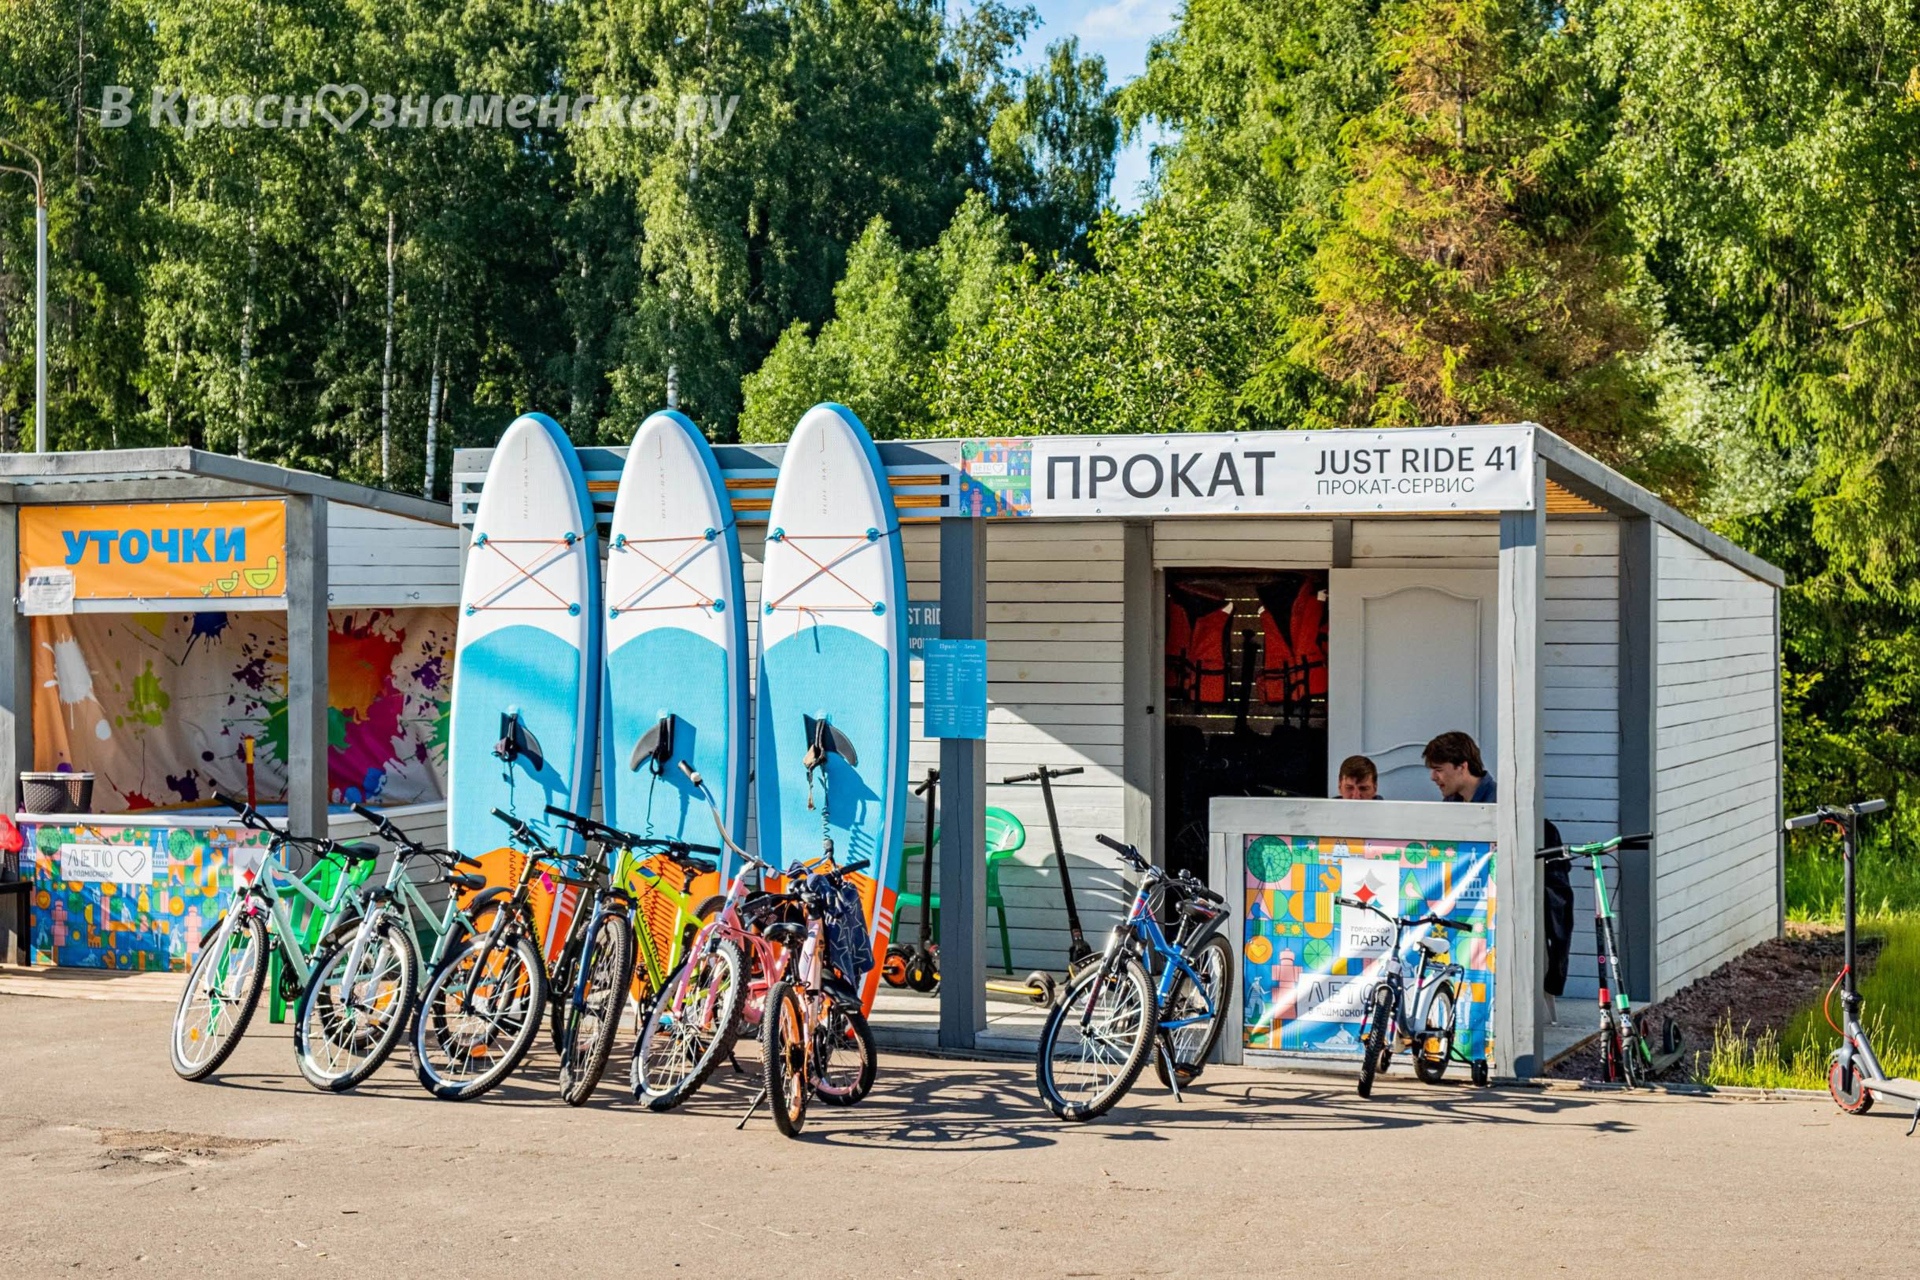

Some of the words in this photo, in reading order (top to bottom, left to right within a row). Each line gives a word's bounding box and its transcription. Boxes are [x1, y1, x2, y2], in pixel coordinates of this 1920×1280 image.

[1314, 449, 1391, 475] JUST
[1402, 447, 1475, 473] RIDE
[1484, 446, 1517, 471] 41
[1047, 451, 1276, 499] ПРОКАТ
[1317, 477, 1475, 495] ПРОКАТ-СЕРВИС
[61, 527, 246, 565] УТОЧКИ
[908, 607, 921, 625] ST
[924, 607, 941, 625] RID
[67, 849, 113, 868] ЛЕТО
[1350, 934, 1392, 948] ПАРК
